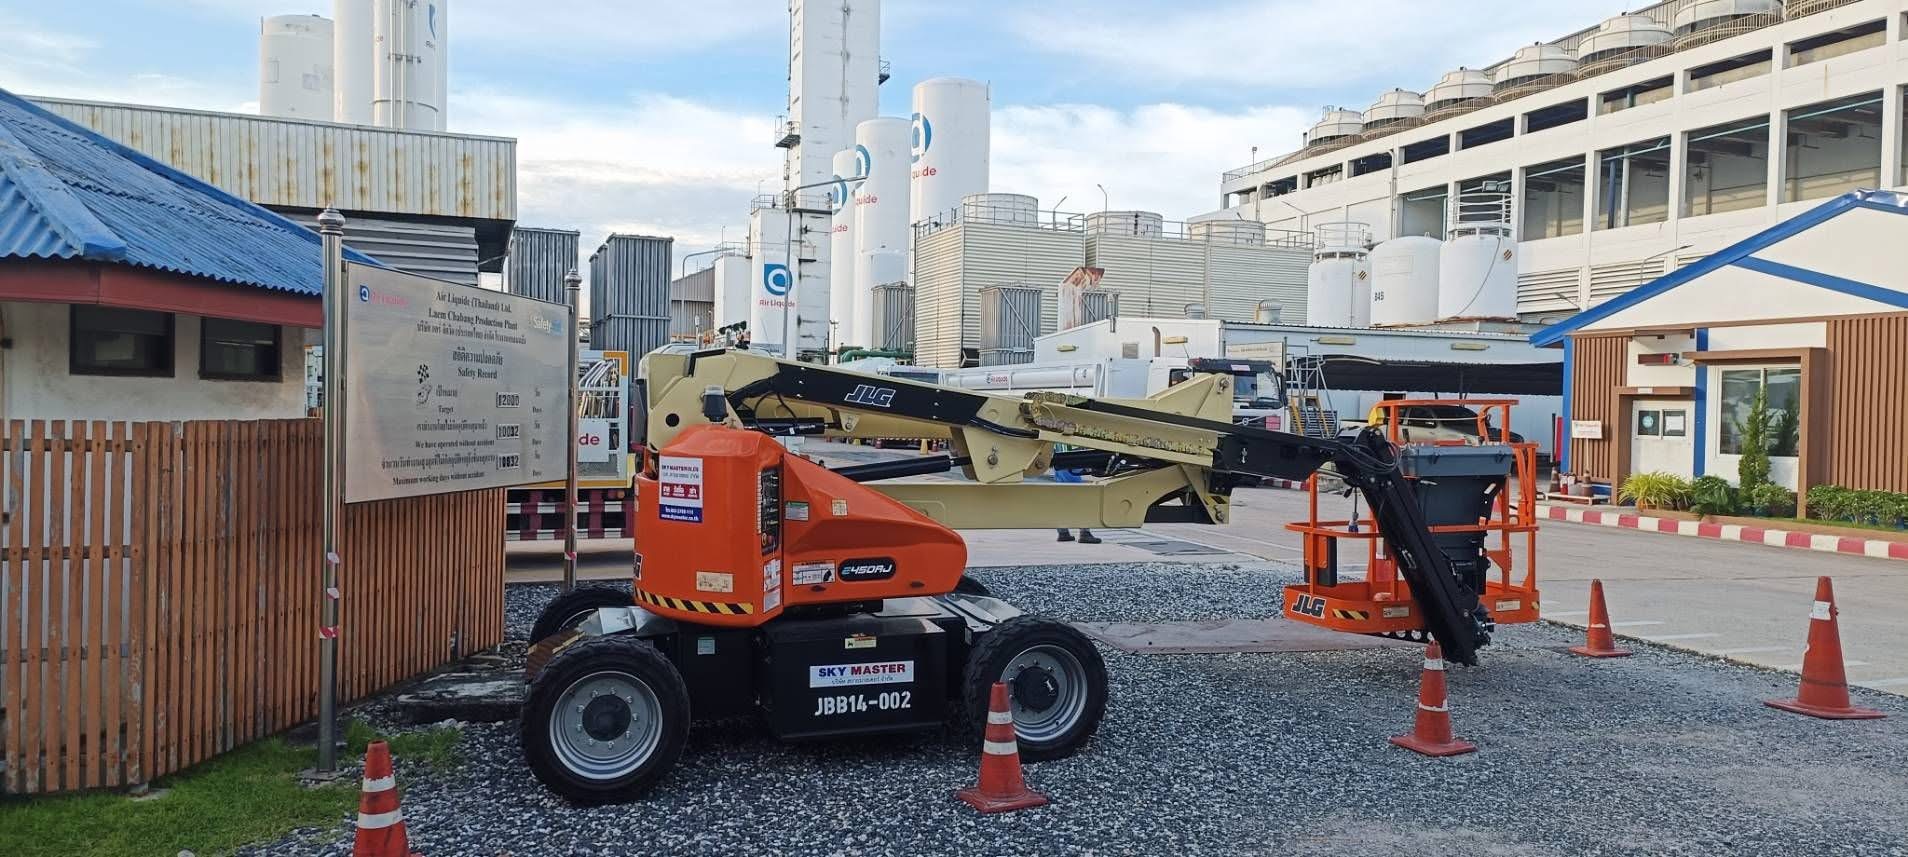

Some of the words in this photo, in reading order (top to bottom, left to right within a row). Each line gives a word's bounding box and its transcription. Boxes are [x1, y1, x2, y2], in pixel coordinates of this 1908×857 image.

[436, 291, 446, 302] Air
[770, 299, 795, 308] Liqude
[457, 367, 476, 380] Safety
[477, 368, 498, 380] Record
[844, 384, 896, 407] JLG
[578, 433, 600, 446] de
[1291, 593, 1327, 619] JLG
[818, 667, 846, 678] SKY
[851, 663, 906, 676] MASTER
[815, 691, 911, 716] JBB14-002
